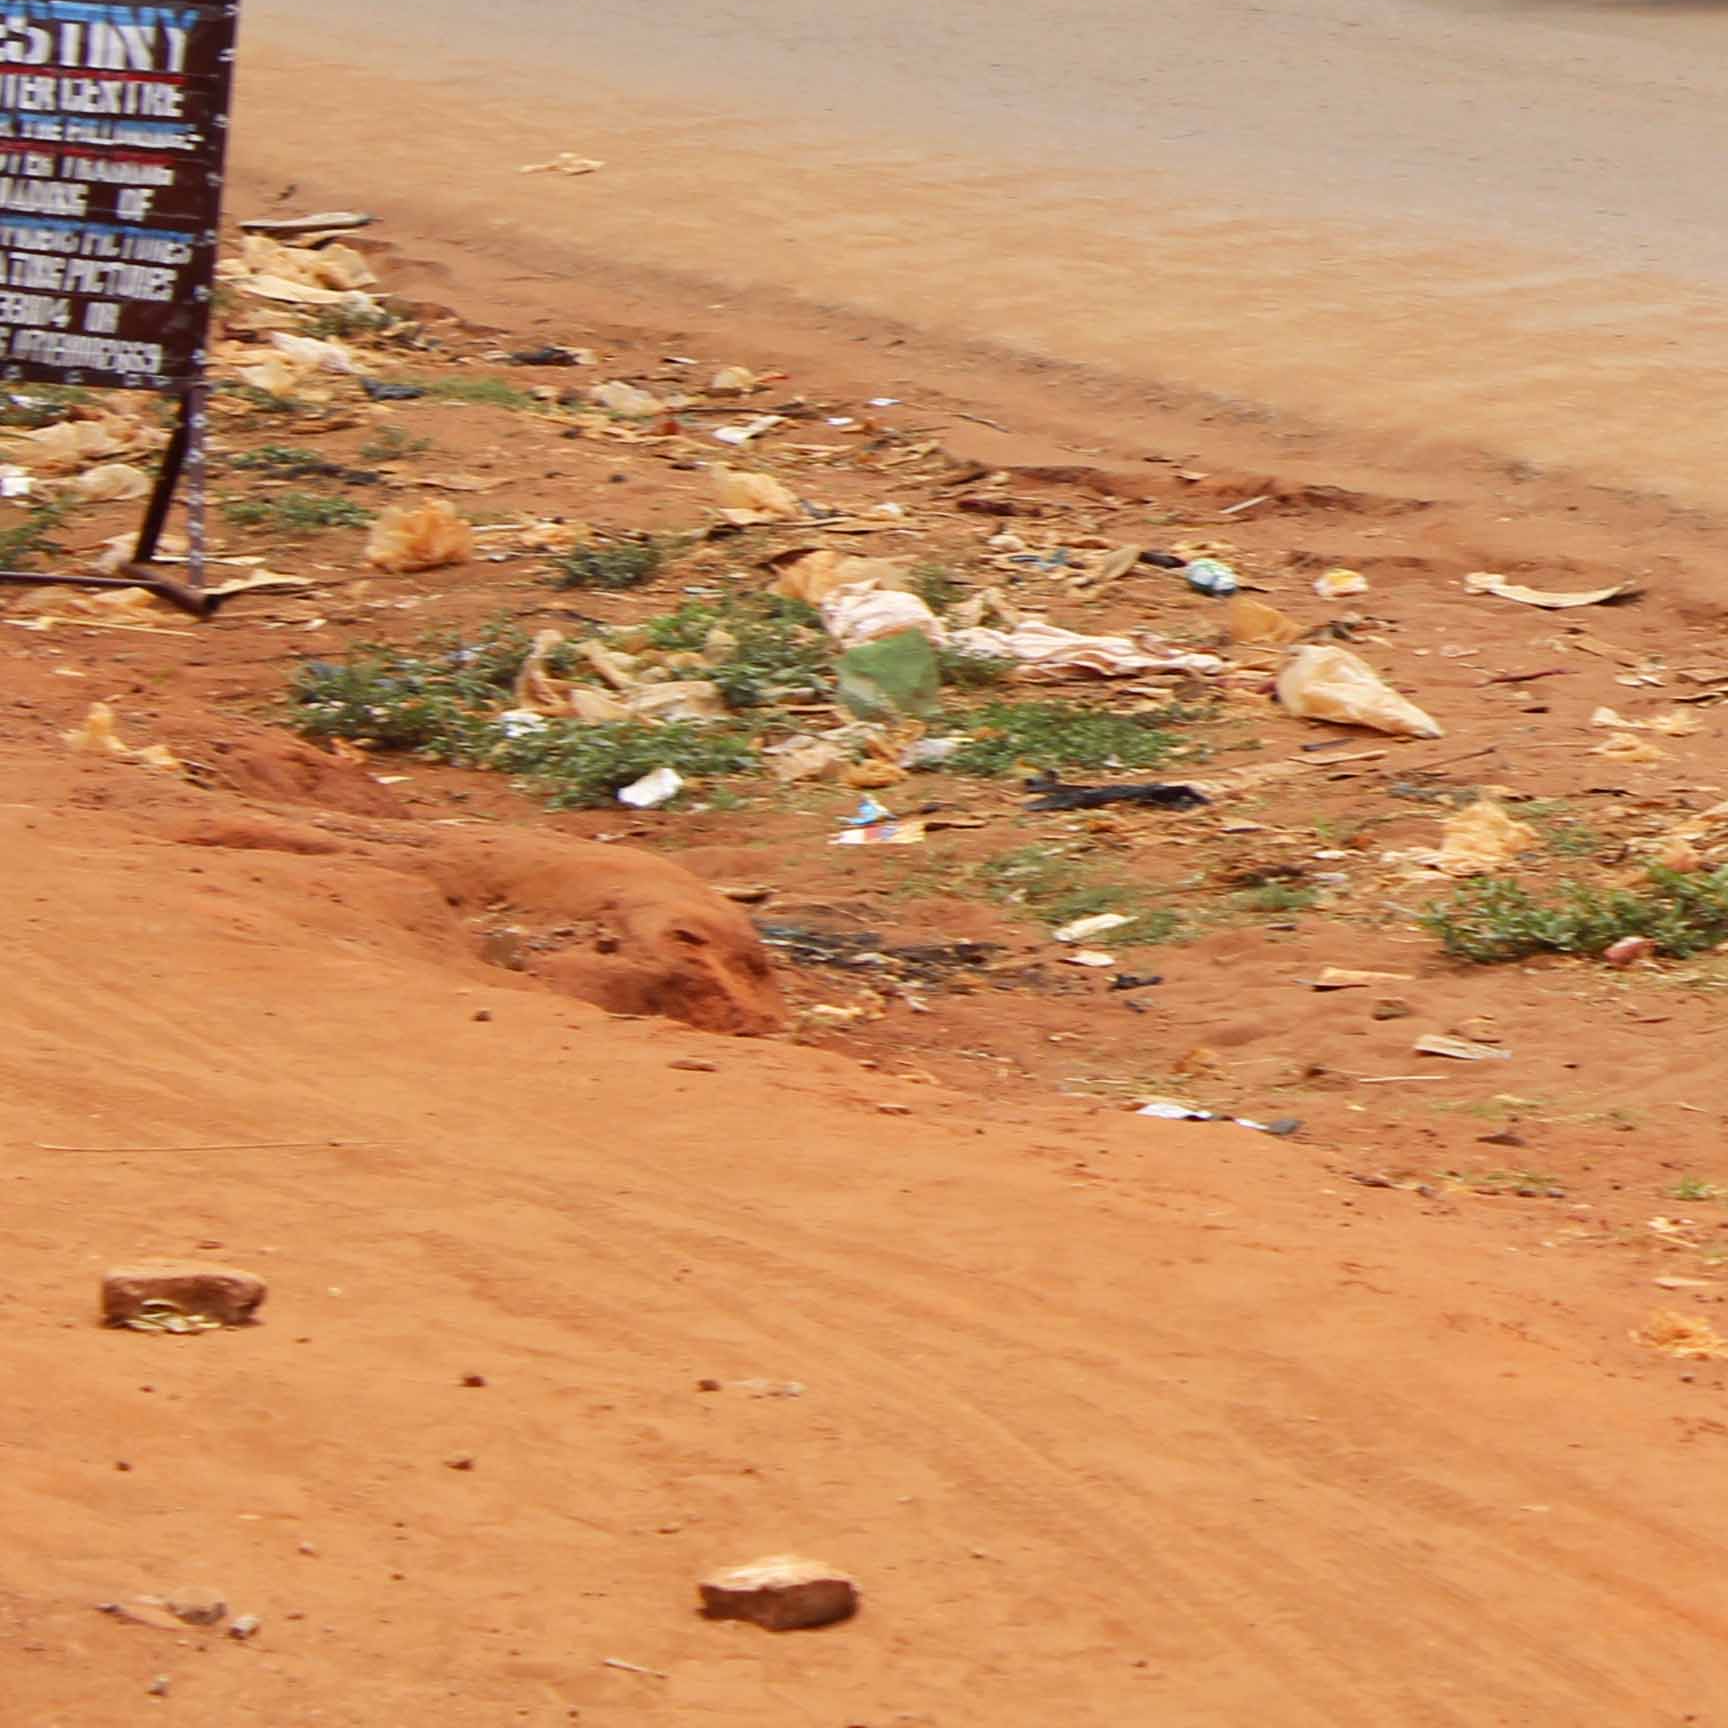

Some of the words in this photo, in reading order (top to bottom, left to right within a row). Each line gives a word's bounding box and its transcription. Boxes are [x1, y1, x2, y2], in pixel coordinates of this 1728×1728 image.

[0, 0, 200, 73] STINY
[0, 66, 58, 112] TER
[60, 68, 188, 118] CENTRE
